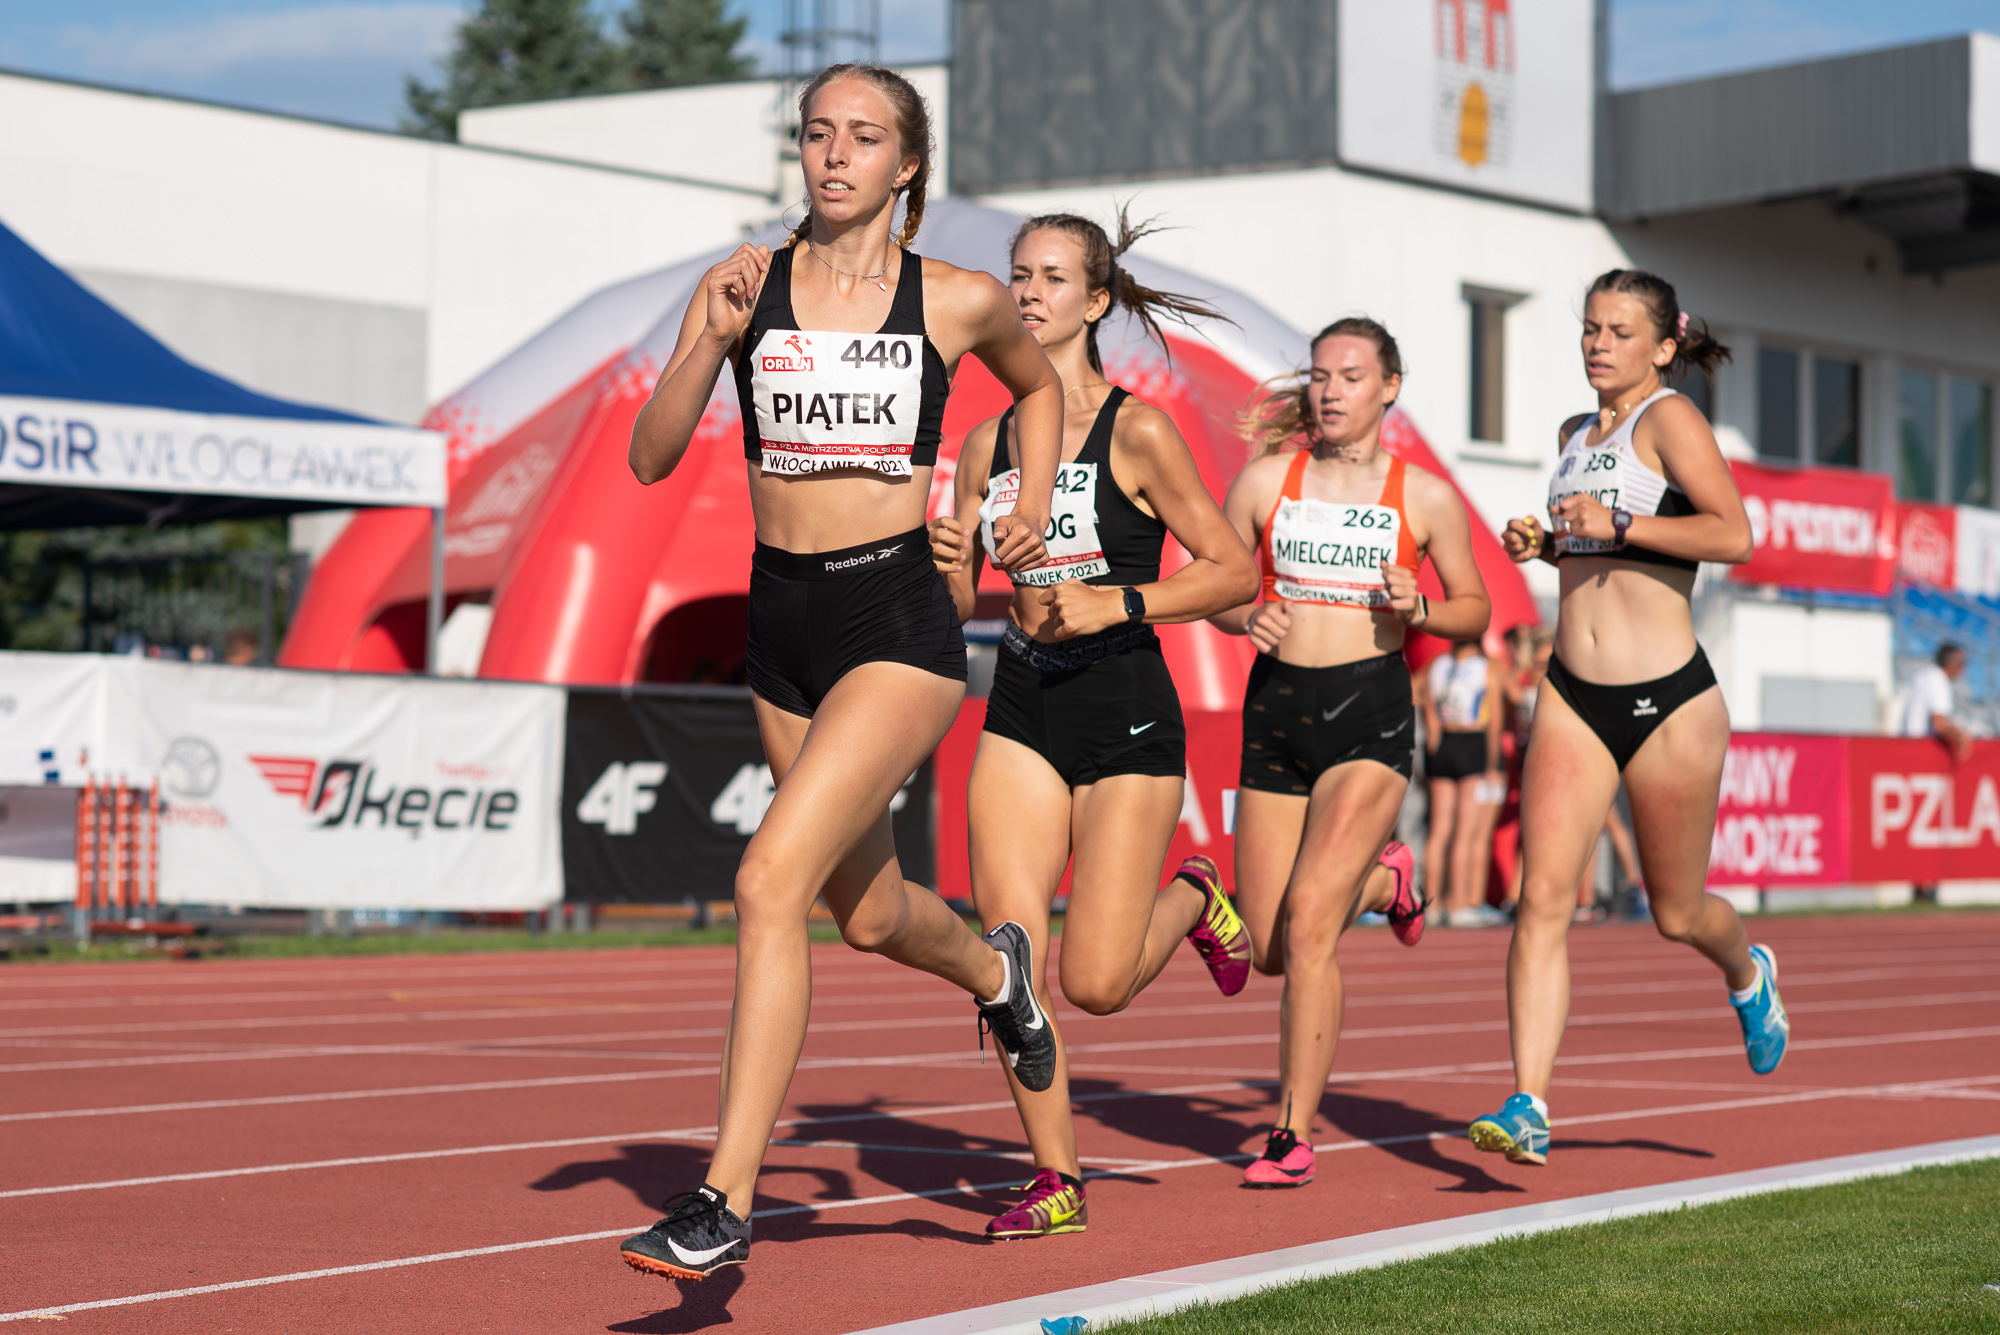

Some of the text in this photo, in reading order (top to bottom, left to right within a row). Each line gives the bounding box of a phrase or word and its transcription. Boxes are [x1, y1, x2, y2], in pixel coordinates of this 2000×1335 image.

[763, 357, 813, 372] ORLEN
[841, 339, 913, 370] 440
[772, 392, 898, 431] PIĄTEK
[0, 413, 418, 493] SiR WŁOCŁAWEK
[801, 445, 862, 454] MISTRZOSTWA
[873, 460, 906, 473] 2021
[1342, 508, 1392, 531] 262
[825, 553, 875, 571] Reebok
[1276, 538, 1392, 570] MIELCZAREK
[1067, 562, 1100, 579] 2021
[576, 761, 668, 835] 4F
